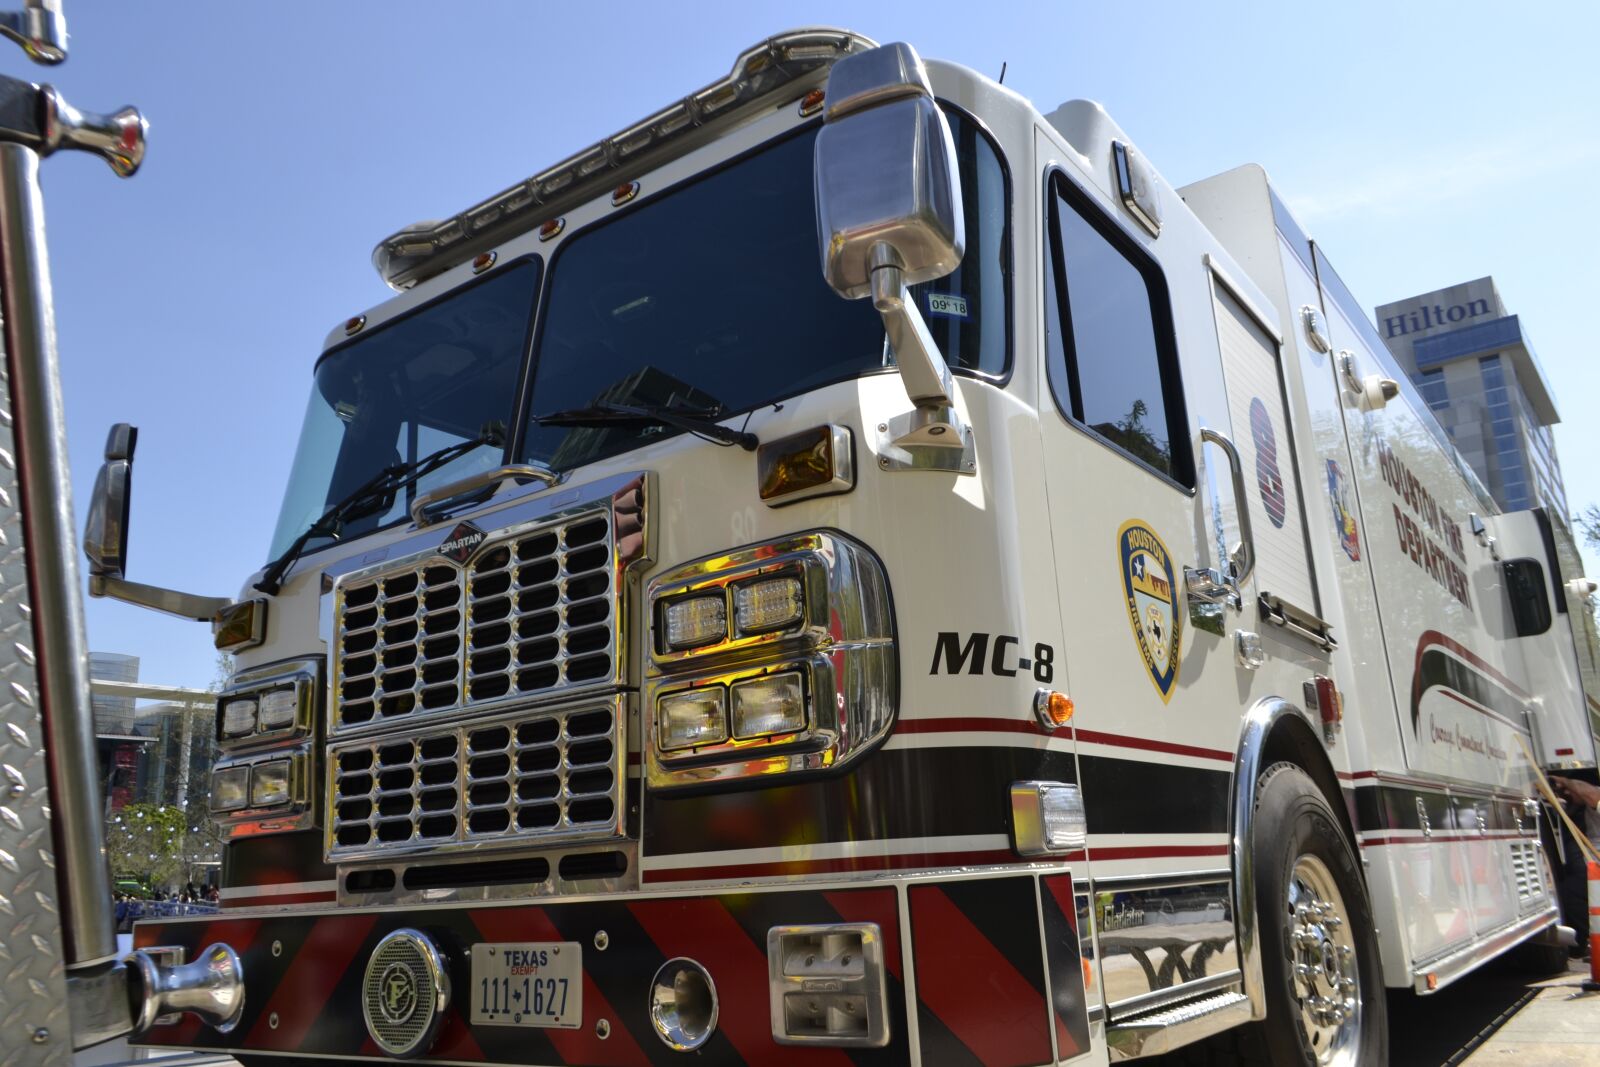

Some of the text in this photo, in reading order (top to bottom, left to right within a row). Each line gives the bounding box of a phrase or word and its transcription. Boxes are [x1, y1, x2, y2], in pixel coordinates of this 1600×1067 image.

[932, 300, 966, 313] 09 18
[1384, 298, 1491, 338] Hilton
[1376, 431, 1443, 541] HOUSTON
[440, 532, 482, 554] SPARTAN
[1127, 529, 1165, 569] HOUSTON
[929, 632, 1054, 684] MC-8
[504, 950, 548, 967] TEXAS
[511, 966, 538, 976] EXEMPT
